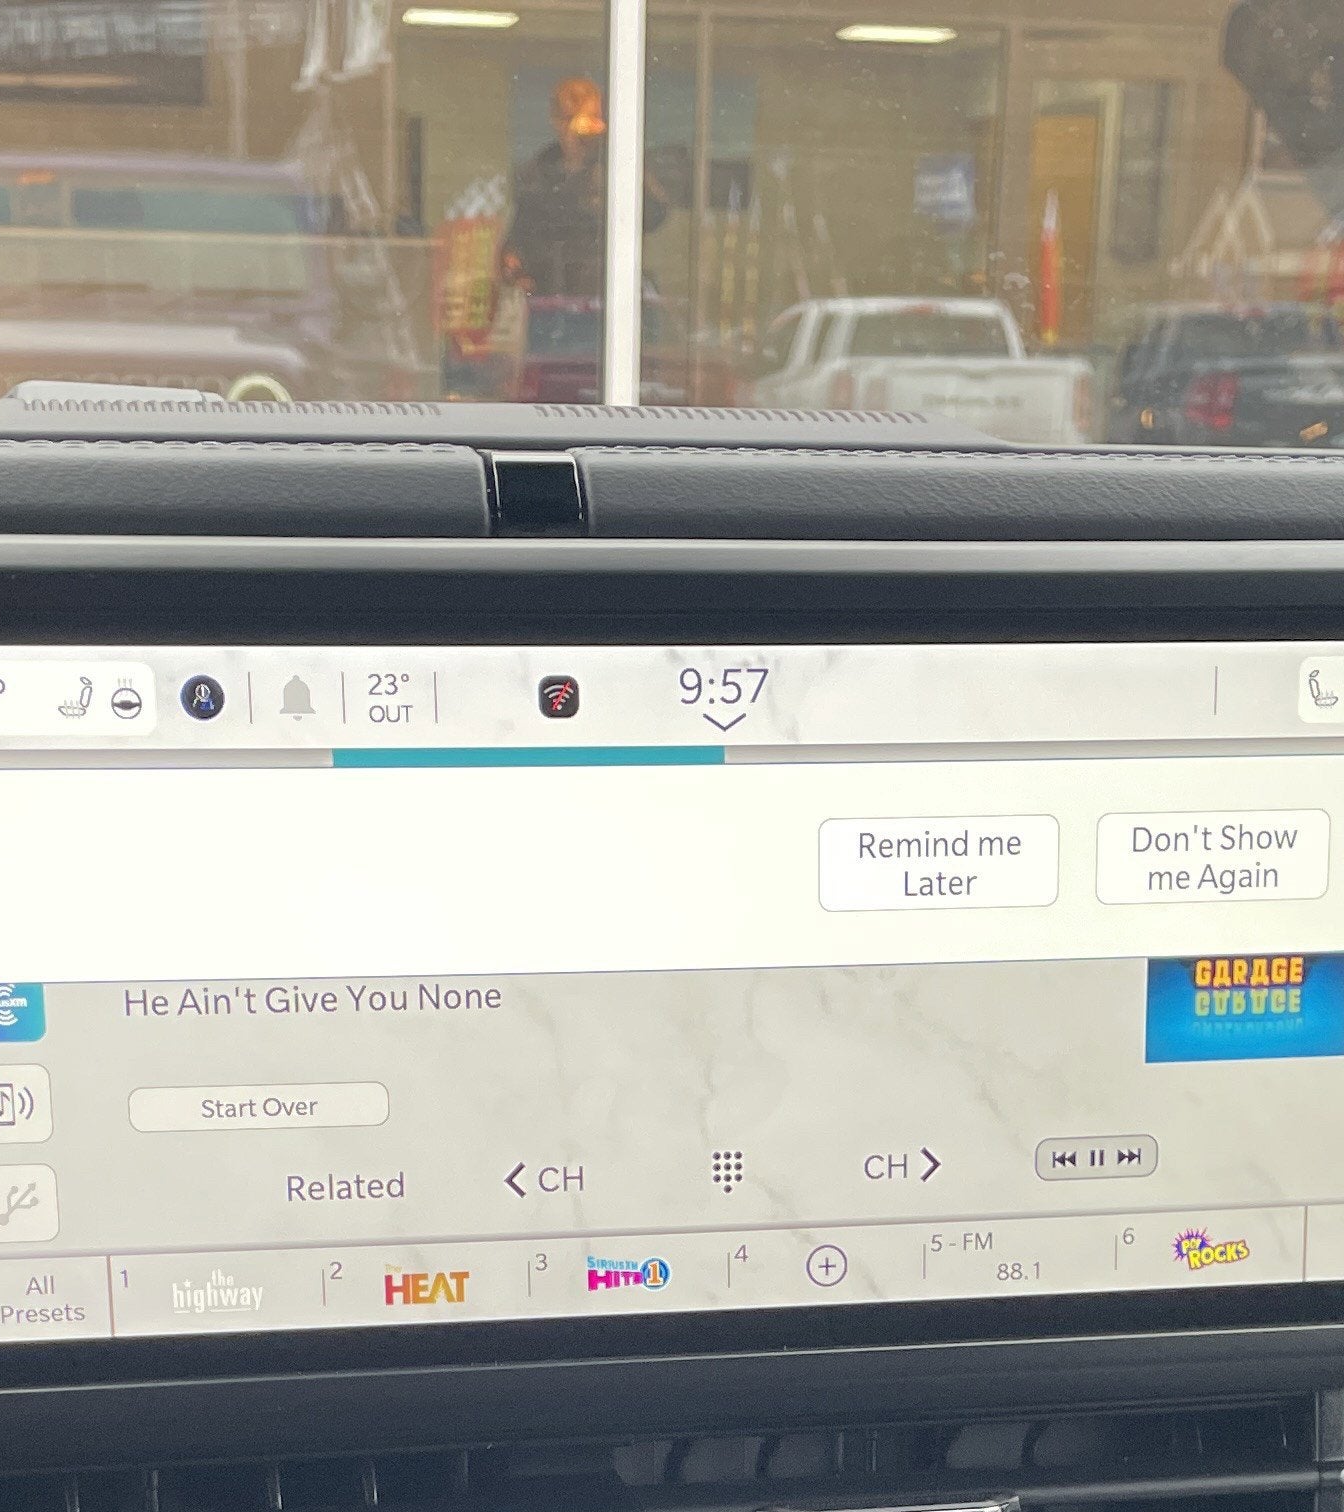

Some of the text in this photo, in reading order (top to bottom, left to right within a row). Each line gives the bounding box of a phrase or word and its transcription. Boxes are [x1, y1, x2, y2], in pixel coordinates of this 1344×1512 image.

[679, 667, 769, 705] 9:57
[369, 704, 413, 724] OUT
[858, 831, 1022, 858] Remind me
[1132, 824, 1299, 852] Don't Show
[903, 870, 978, 897] Later
[1147, 861, 1279, 895] me Again
[1194, 956, 1305, 989] GARAGE
[124, 983, 502, 1016] He Ain't Give You None
[201, 1097, 319, 1118] Start Over
[538, 1167, 585, 1191] CH
[863, 1154, 909, 1180] CH
[286, 1171, 405, 1200] Related
[930, 1234, 943, 1252] 5
[963, 1232, 994, 1251] FM
[1122, 1228, 1135, 1246] 6
[535, 1253, 548, 1271] 3
[734, 1244, 749, 1263] 4
[1188, 1241, 1250, 1270] ROCKS
[120, 1269, 129, 1288] 1
[211, 1268, 234, 1287] the
[329, 1261, 343, 1280] 2
[996, 1261, 1041, 1281] 88.1
[25, 1275, 55, 1296] All
[172, 1282, 264, 1313] highway
[384, 1271, 470, 1305] HEAT
[0, 1303, 86, 1324] Presets
